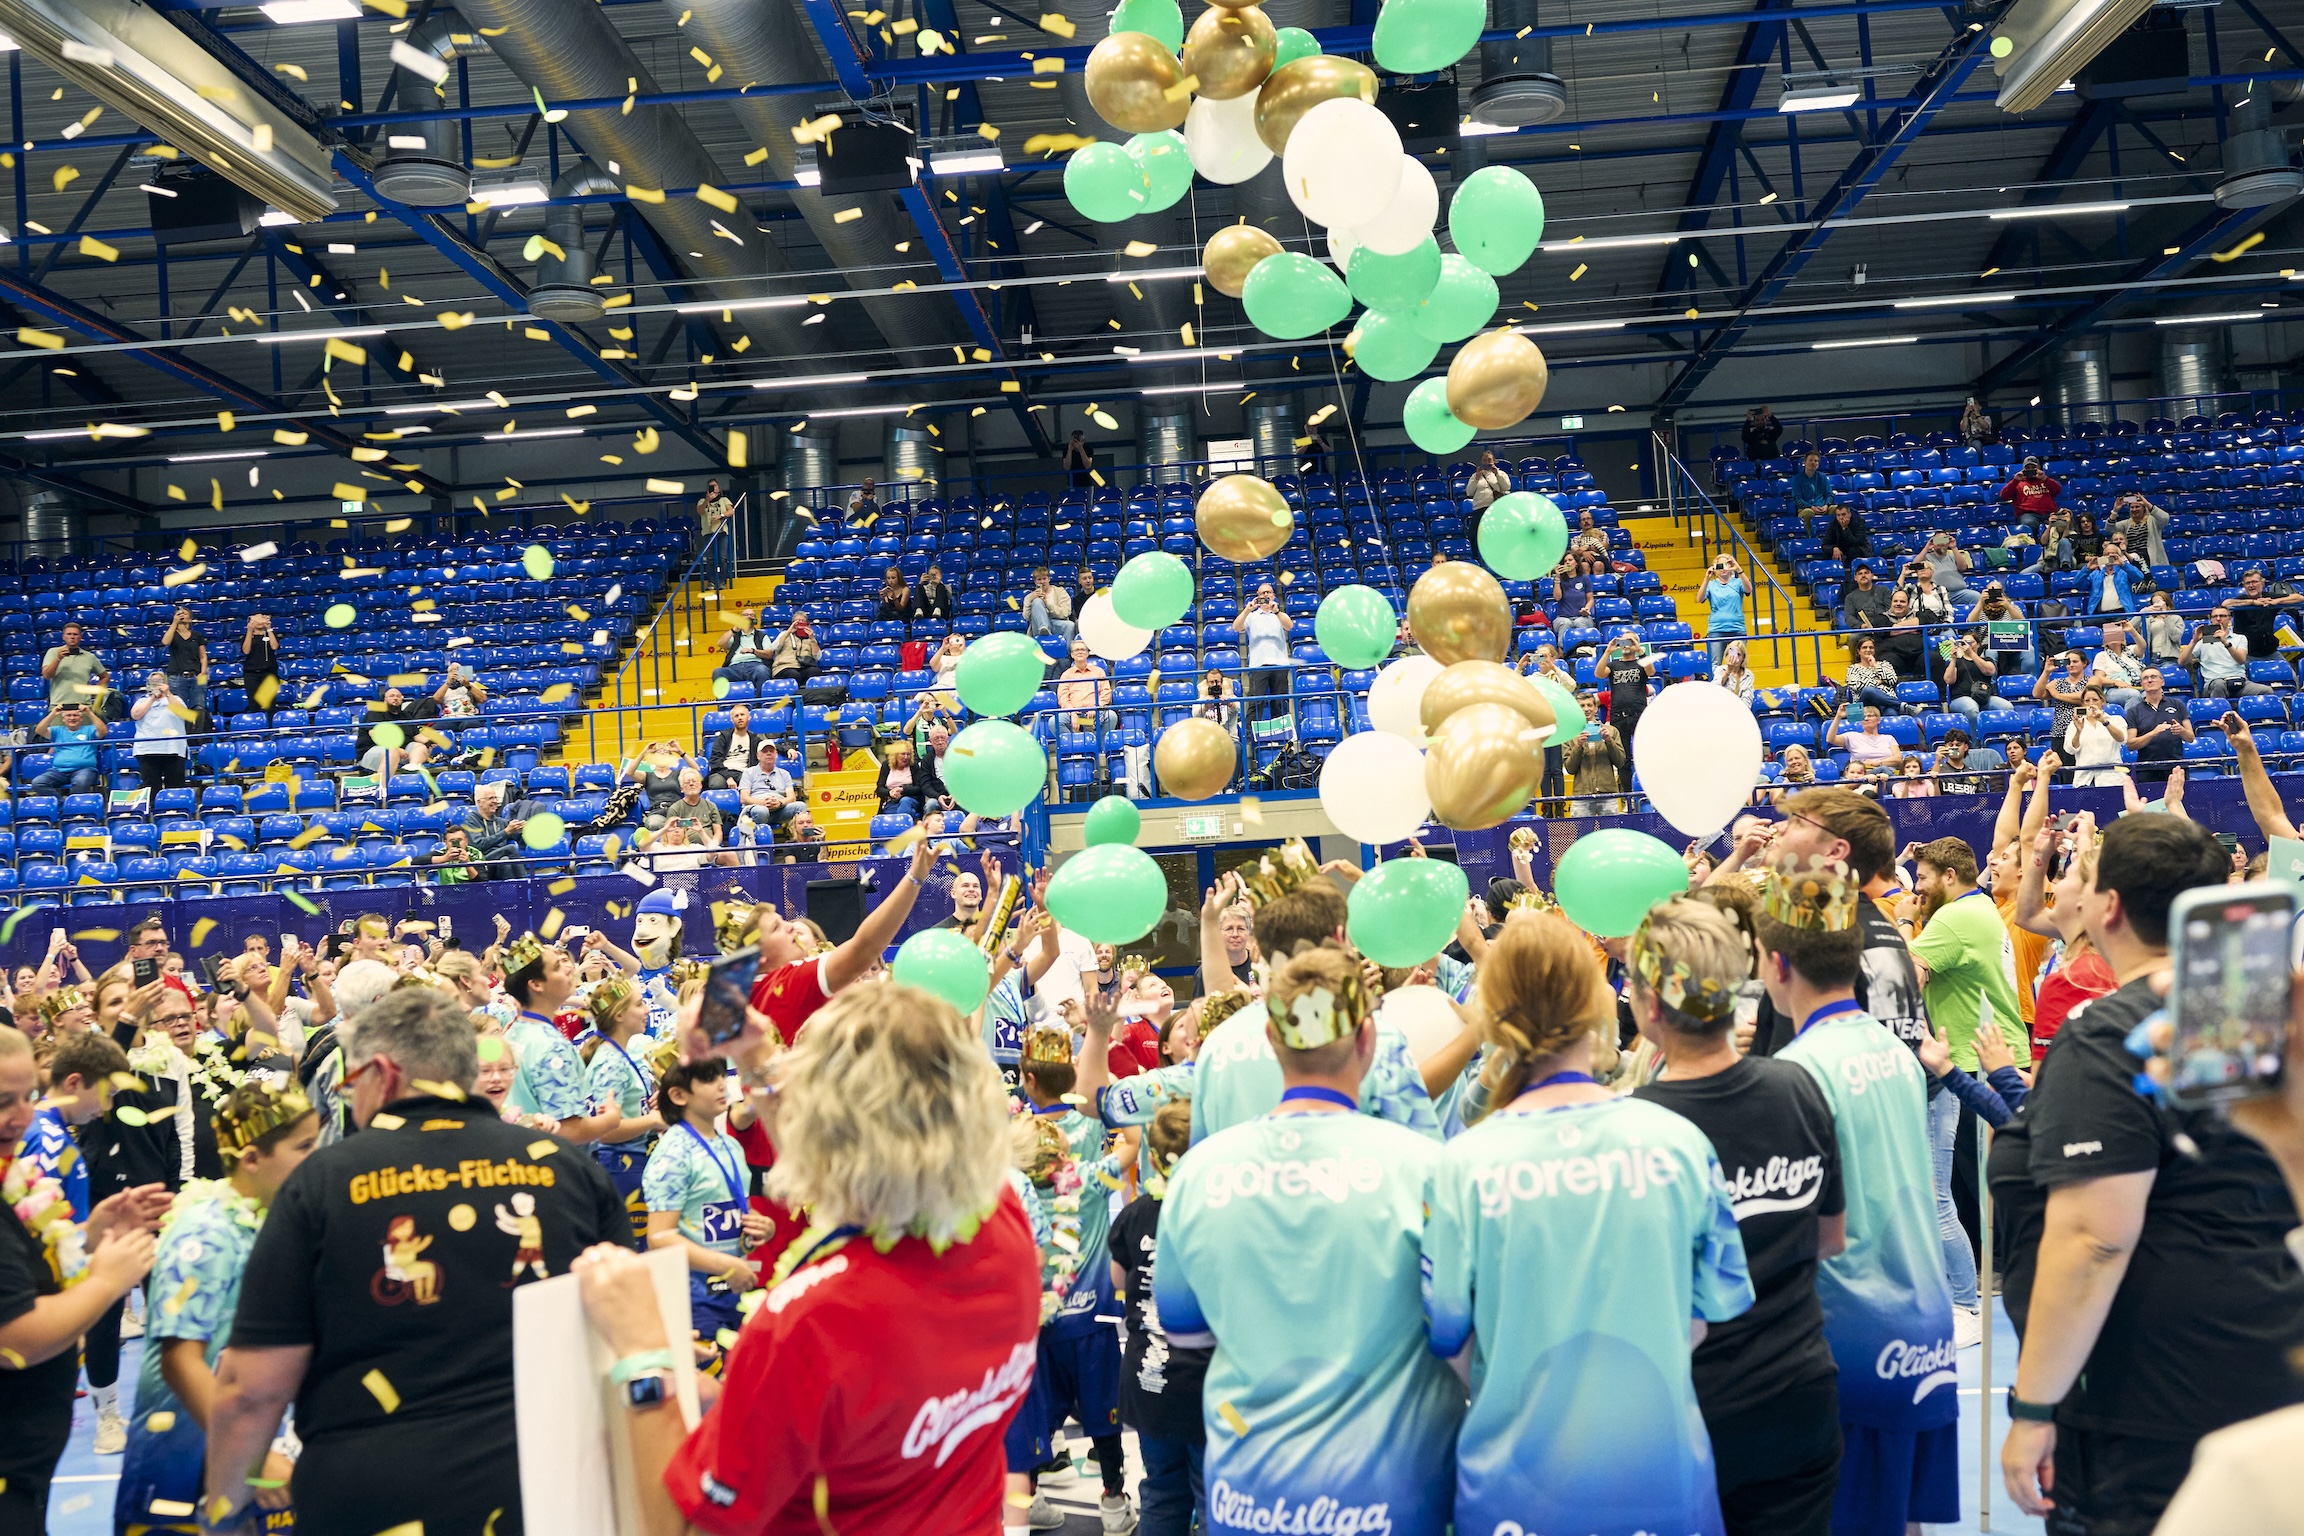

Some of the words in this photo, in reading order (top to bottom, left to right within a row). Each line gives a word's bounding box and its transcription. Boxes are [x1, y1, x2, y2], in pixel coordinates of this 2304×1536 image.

[1641, 541, 1675, 550] Lippische
[1669, 583, 1701, 592] Lippisch
[833, 790, 880, 803] Lippisch
[828, 845, 870, 858] ippische
[350, 1157, 556, 1205] Glücks-Füchse
[1206, 1146, 1384, 1208] gorenje
[1475, 1135, 1679, 1218] gorenje
[1211, 1477, 1393, 1536] Glücksliga
